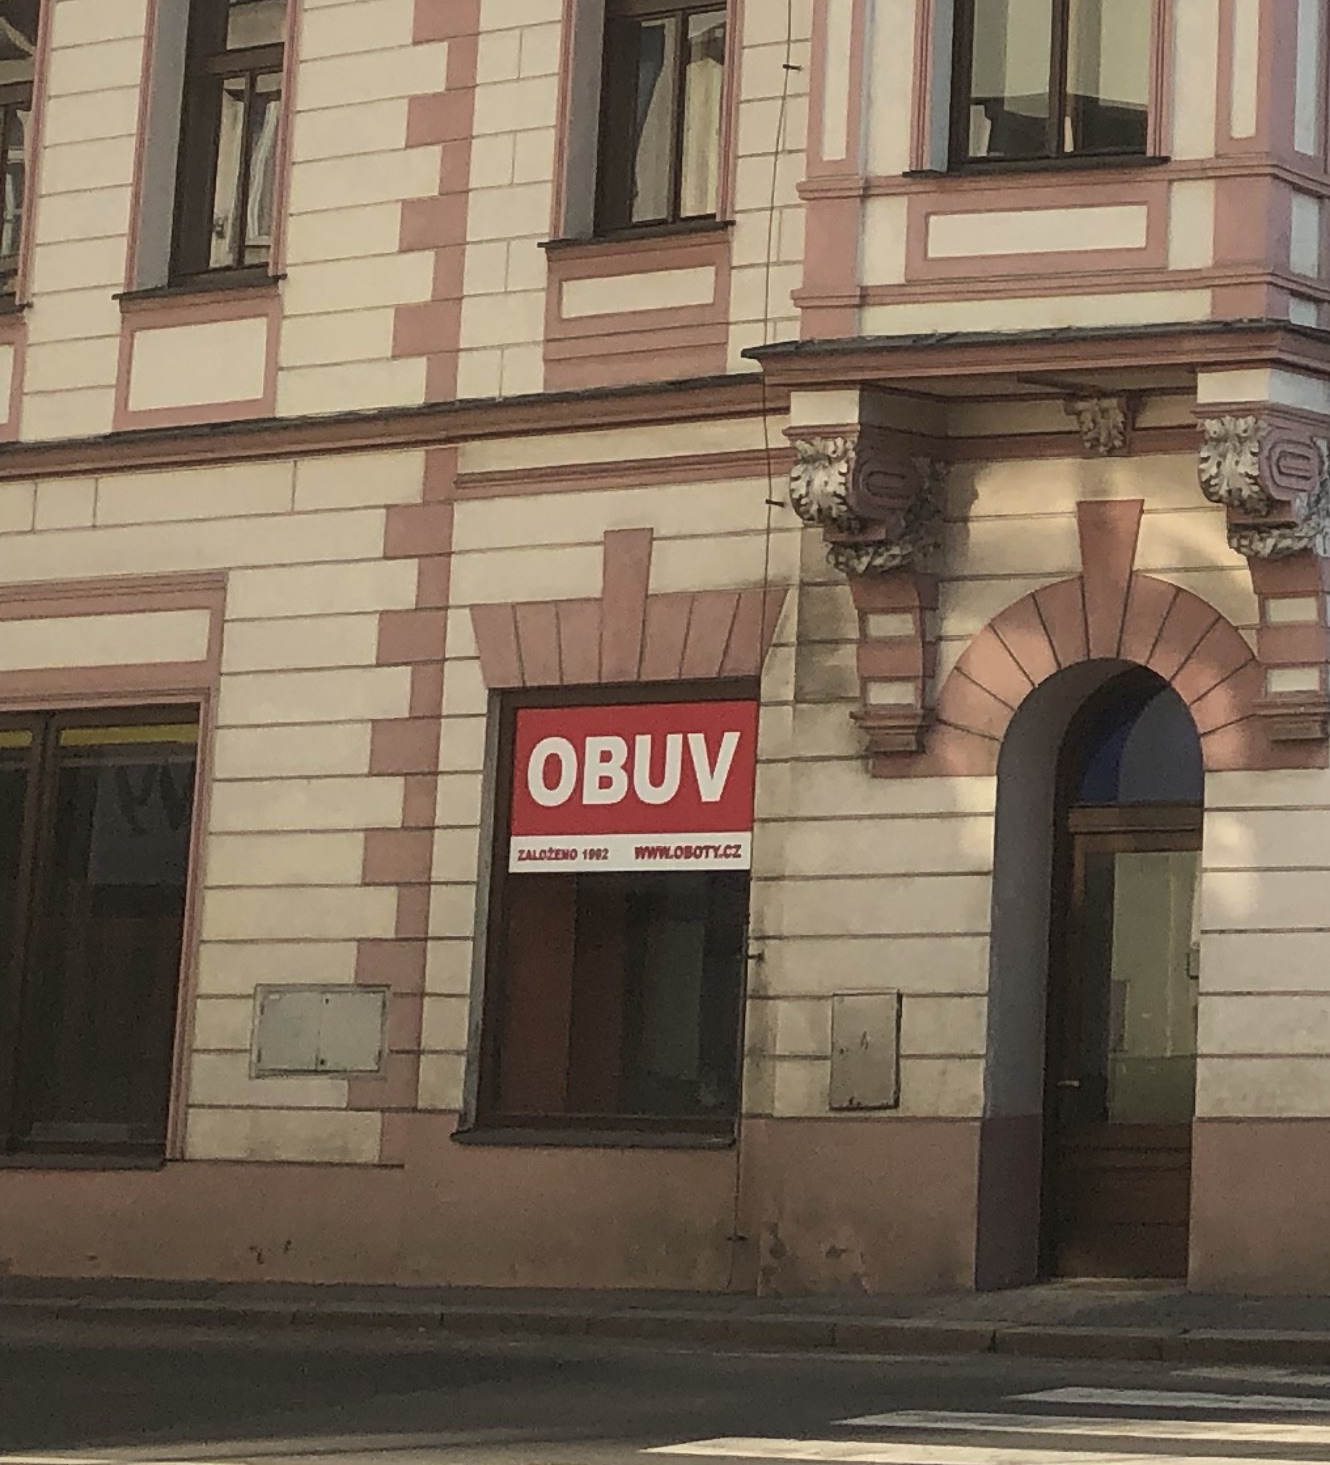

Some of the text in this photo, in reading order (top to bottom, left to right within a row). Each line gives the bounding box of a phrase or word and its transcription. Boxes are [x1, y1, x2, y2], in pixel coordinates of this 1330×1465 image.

[527, 731, 741, 807] OBUV
[517, 847, 578, 861] ZALOŽENO
[634, 844, 742, 860] WWW.OBOTY.CZ
